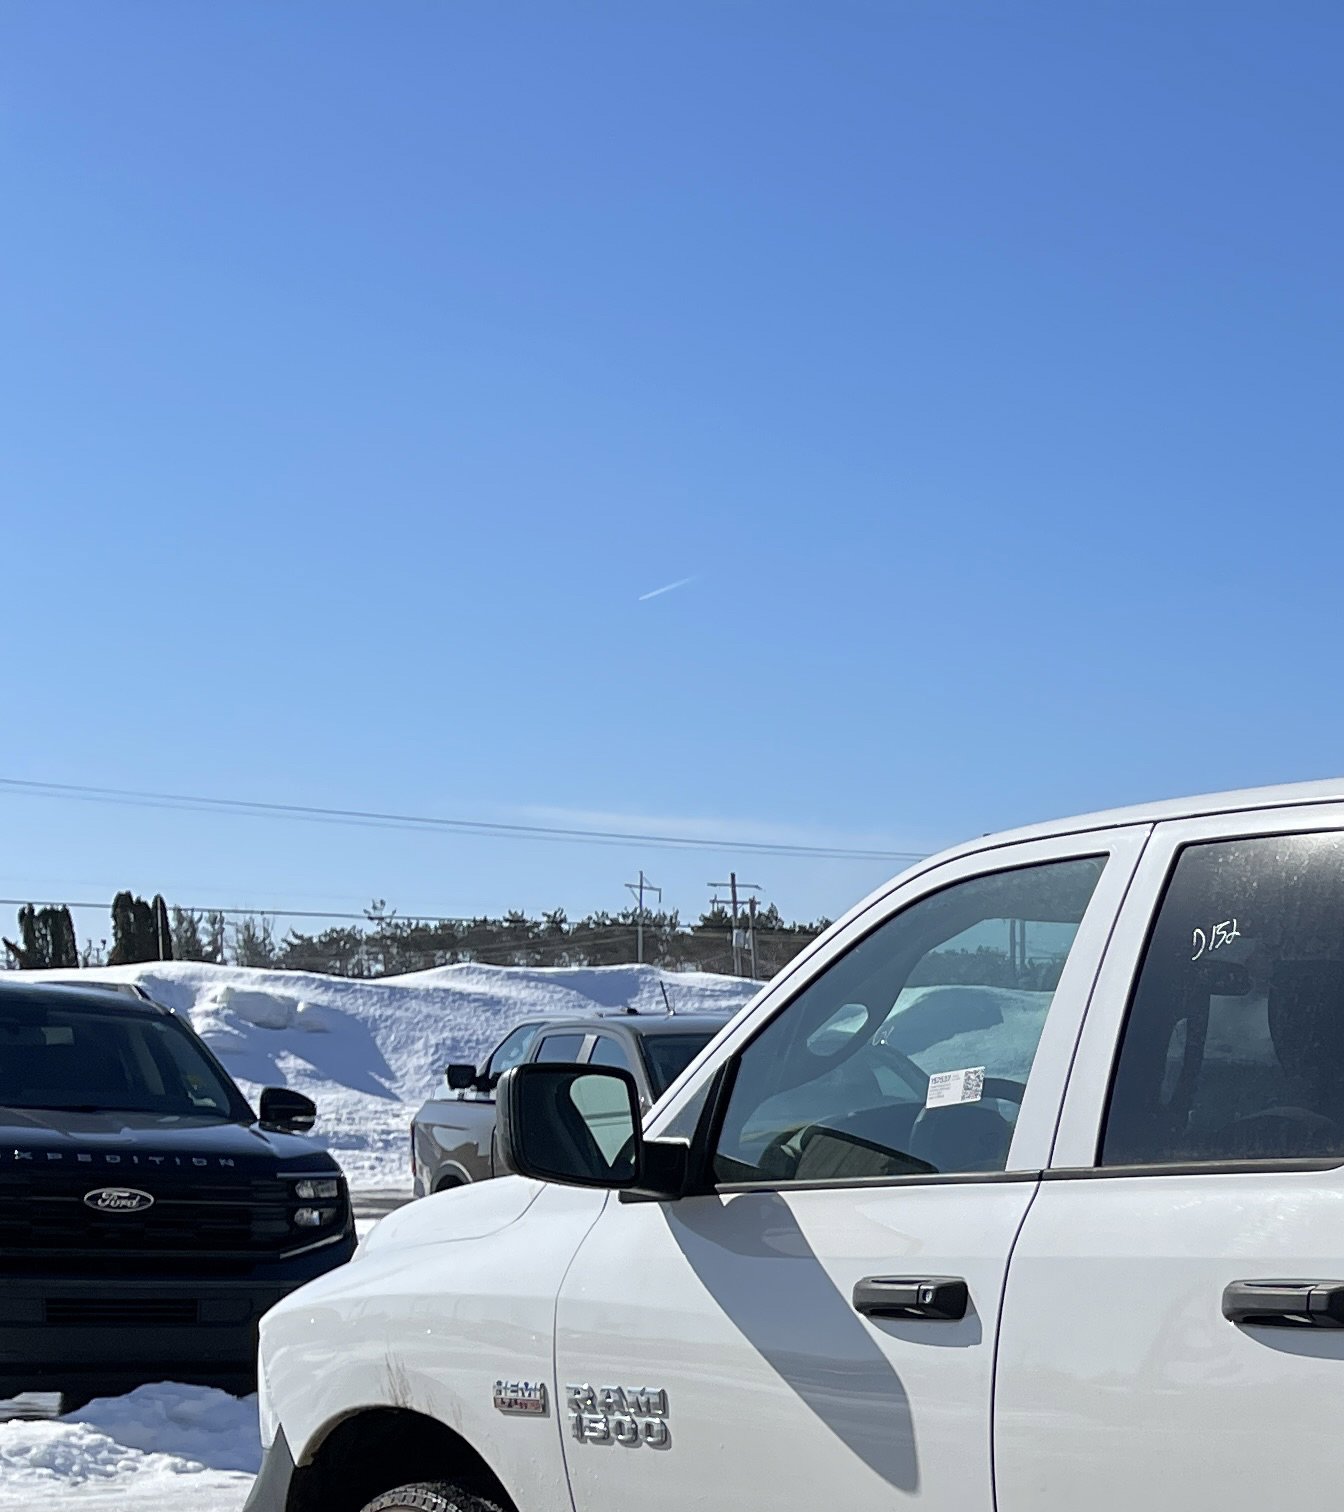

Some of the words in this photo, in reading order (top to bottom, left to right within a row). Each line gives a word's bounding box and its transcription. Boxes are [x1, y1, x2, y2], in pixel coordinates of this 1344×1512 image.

[0, 1150, 235, 1168] XPEDITION
[566, 1383, 669, 1417] RAM
[568, 1412, 669, 1447] 1500
